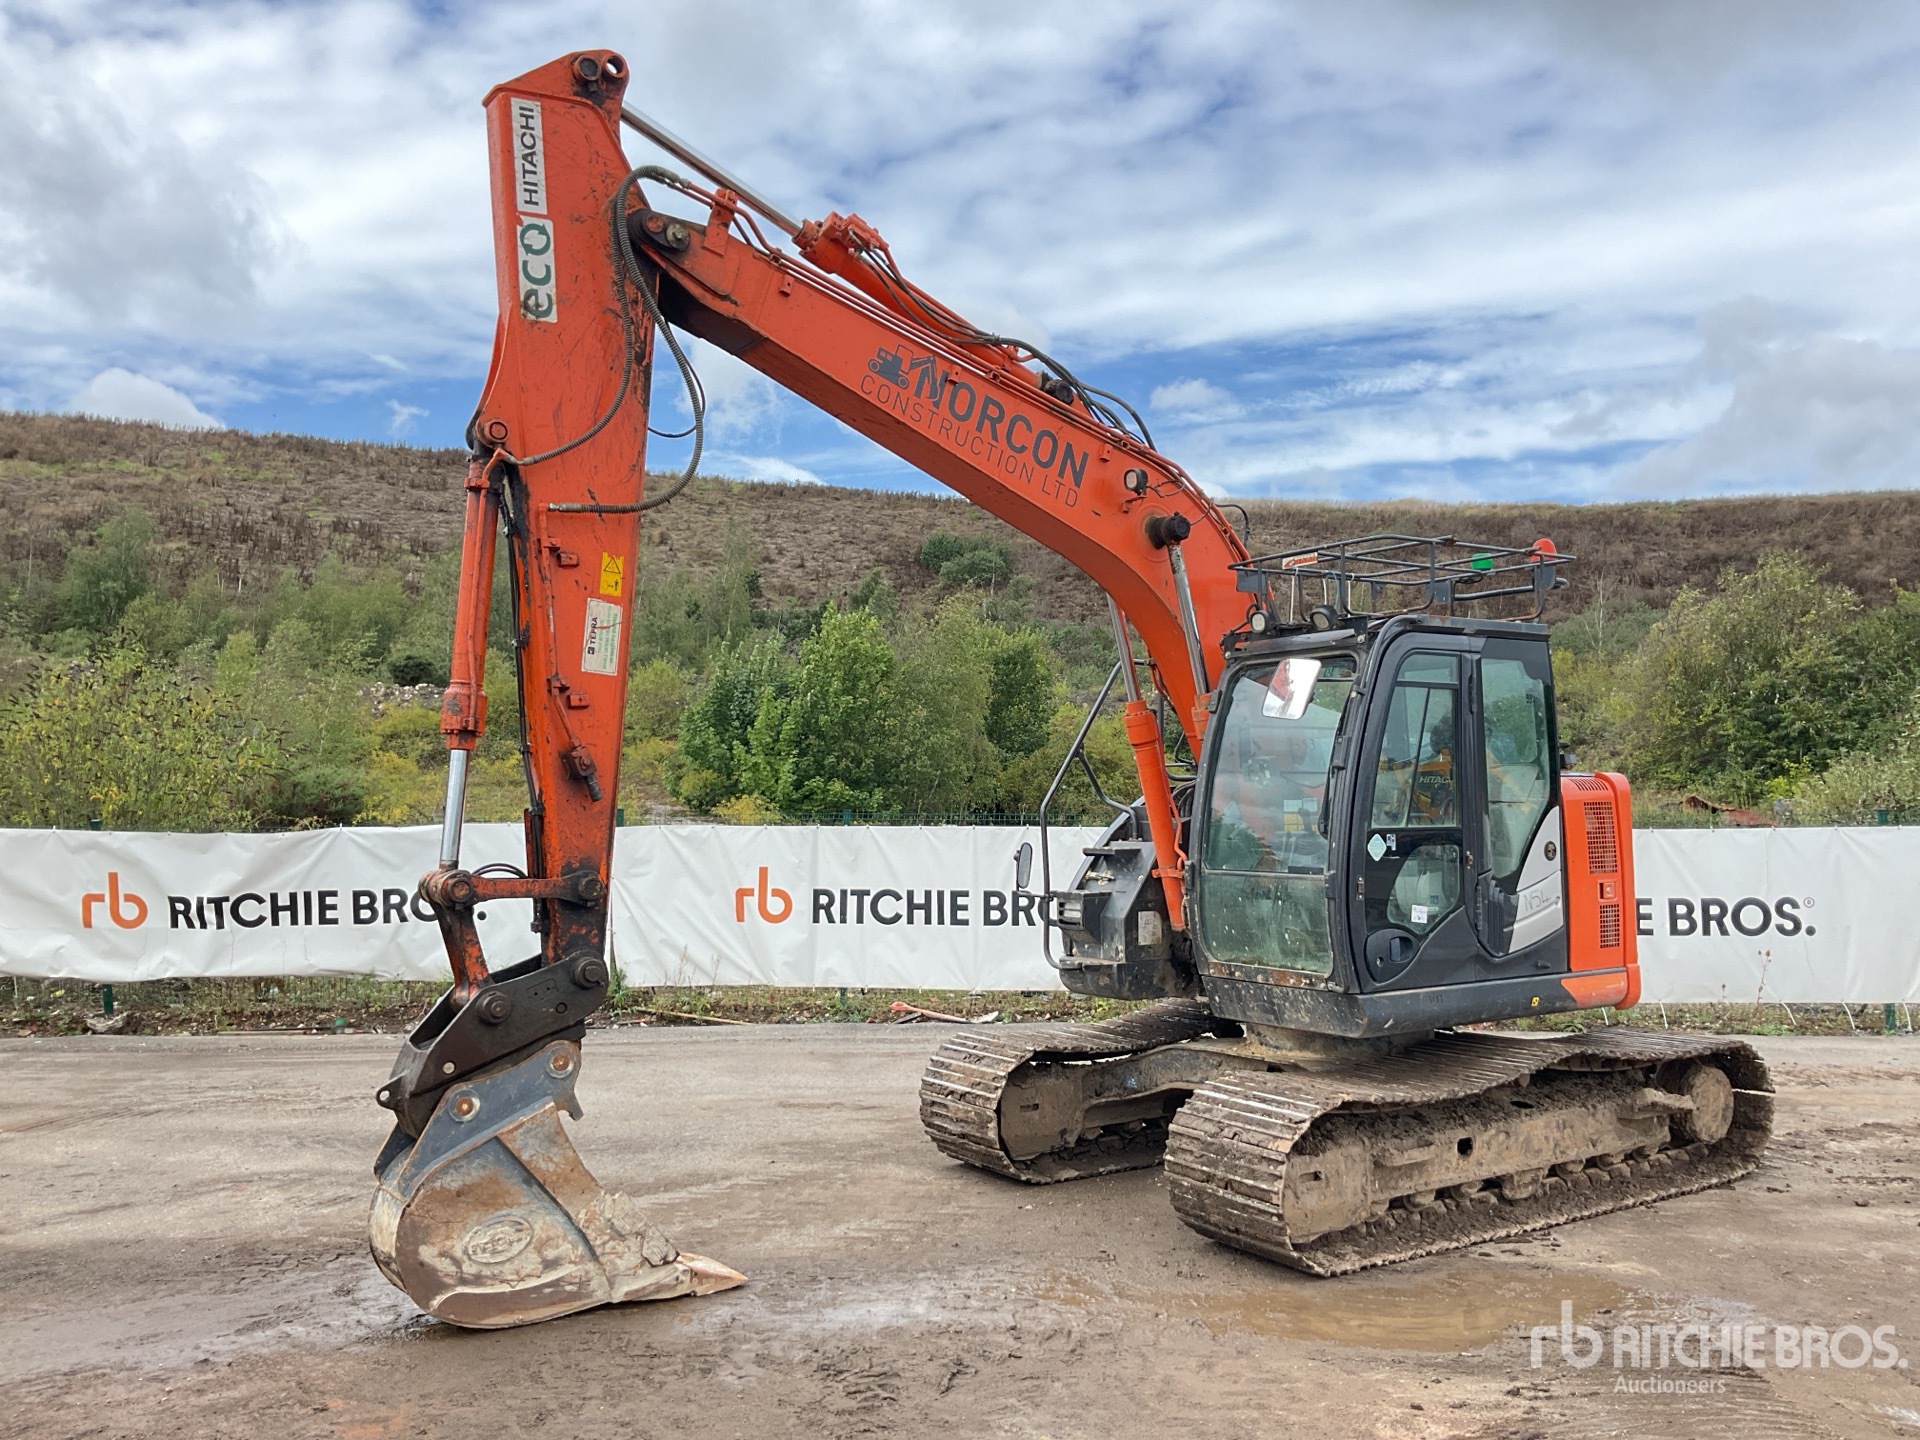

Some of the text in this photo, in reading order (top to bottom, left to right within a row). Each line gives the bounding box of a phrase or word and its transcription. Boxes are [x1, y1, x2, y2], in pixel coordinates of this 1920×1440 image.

[518, 105, 540, 207] HITACHI
[860, 374, 1079, 508] CONSTRUCTION LTD
[913, 366, 1090, 489] NORCON
[1419, 775, 1451, 784] HITAC
[81, 872, 487, 930] rb RITCHIE BRO.
[735, 866, 793, 924] rb
[812, 888, 970, 926] RITCHIE
